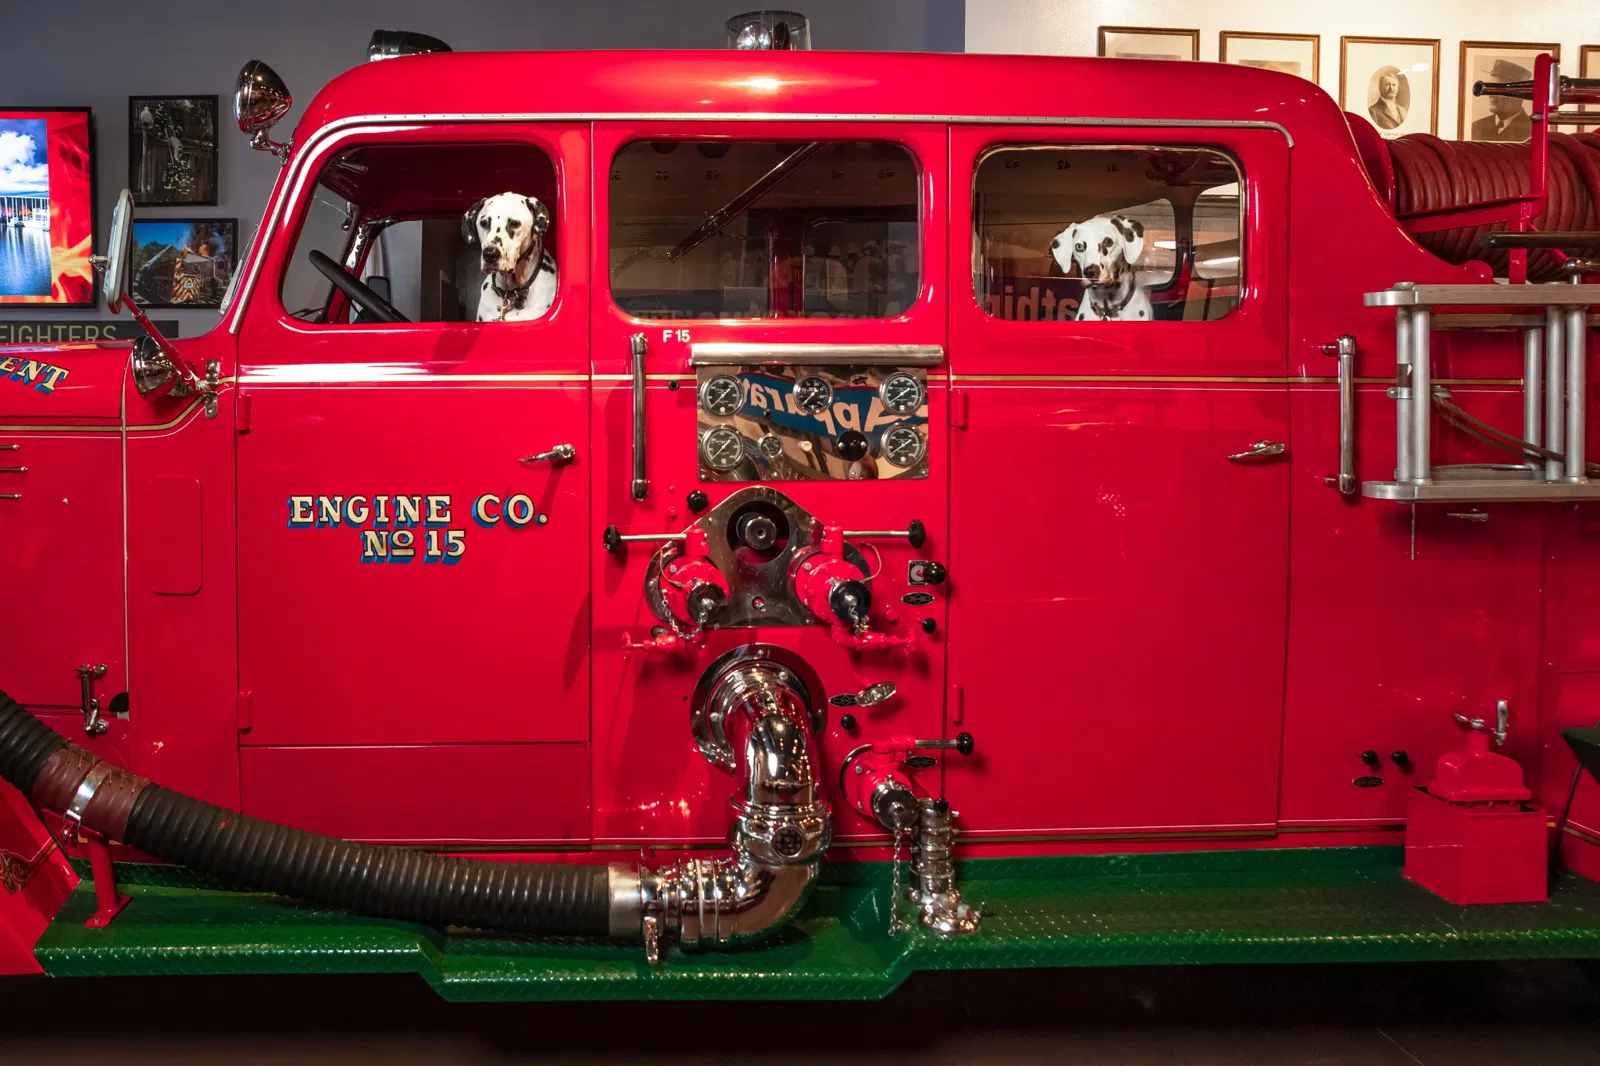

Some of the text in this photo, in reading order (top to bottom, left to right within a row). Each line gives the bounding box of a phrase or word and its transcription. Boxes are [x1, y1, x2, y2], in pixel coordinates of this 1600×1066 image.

[662, 329, 691, 343] F 15
[0, 356, 71, 395] ENT
[287, 493, 549, 529] ENGINE CO.
[423, 529, 466, 566] 15
